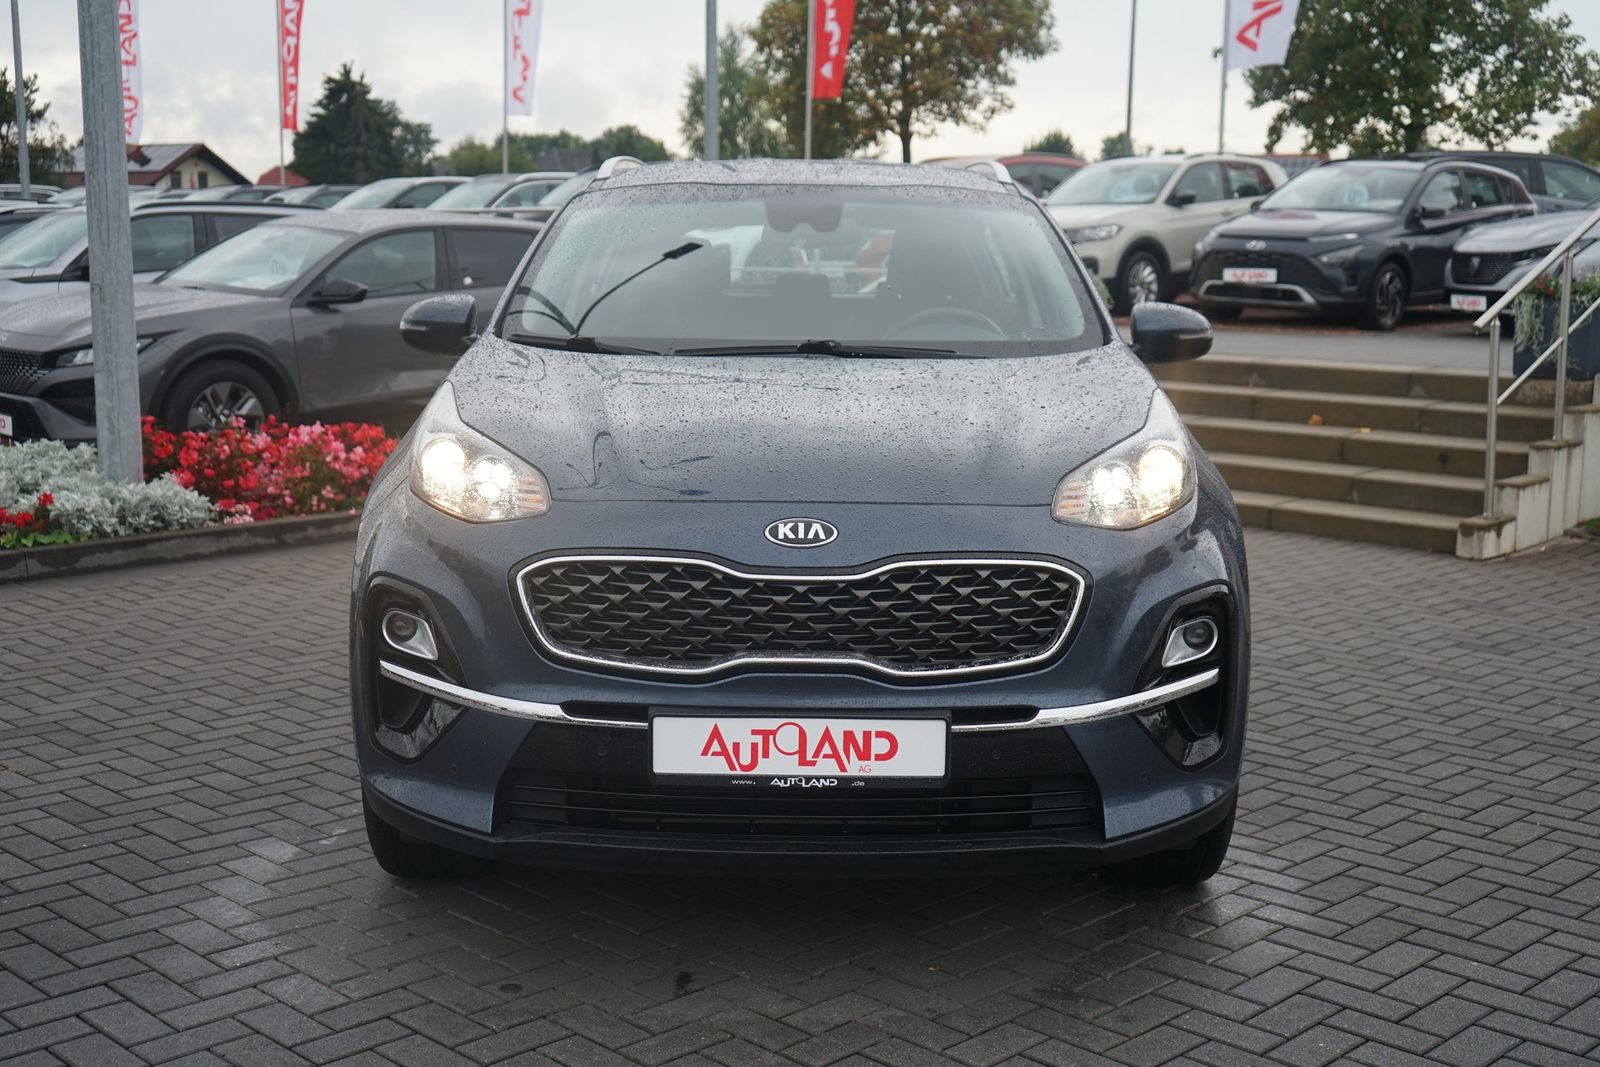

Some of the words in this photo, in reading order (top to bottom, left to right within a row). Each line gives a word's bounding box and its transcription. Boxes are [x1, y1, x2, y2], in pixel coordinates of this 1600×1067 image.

[777, 522, 826, 540] KIA
[700, 721, 899, 773] AUTOLAND
[858, 765, 872, 774] AG
[770, 776, 838, 788] AUTOLAND
